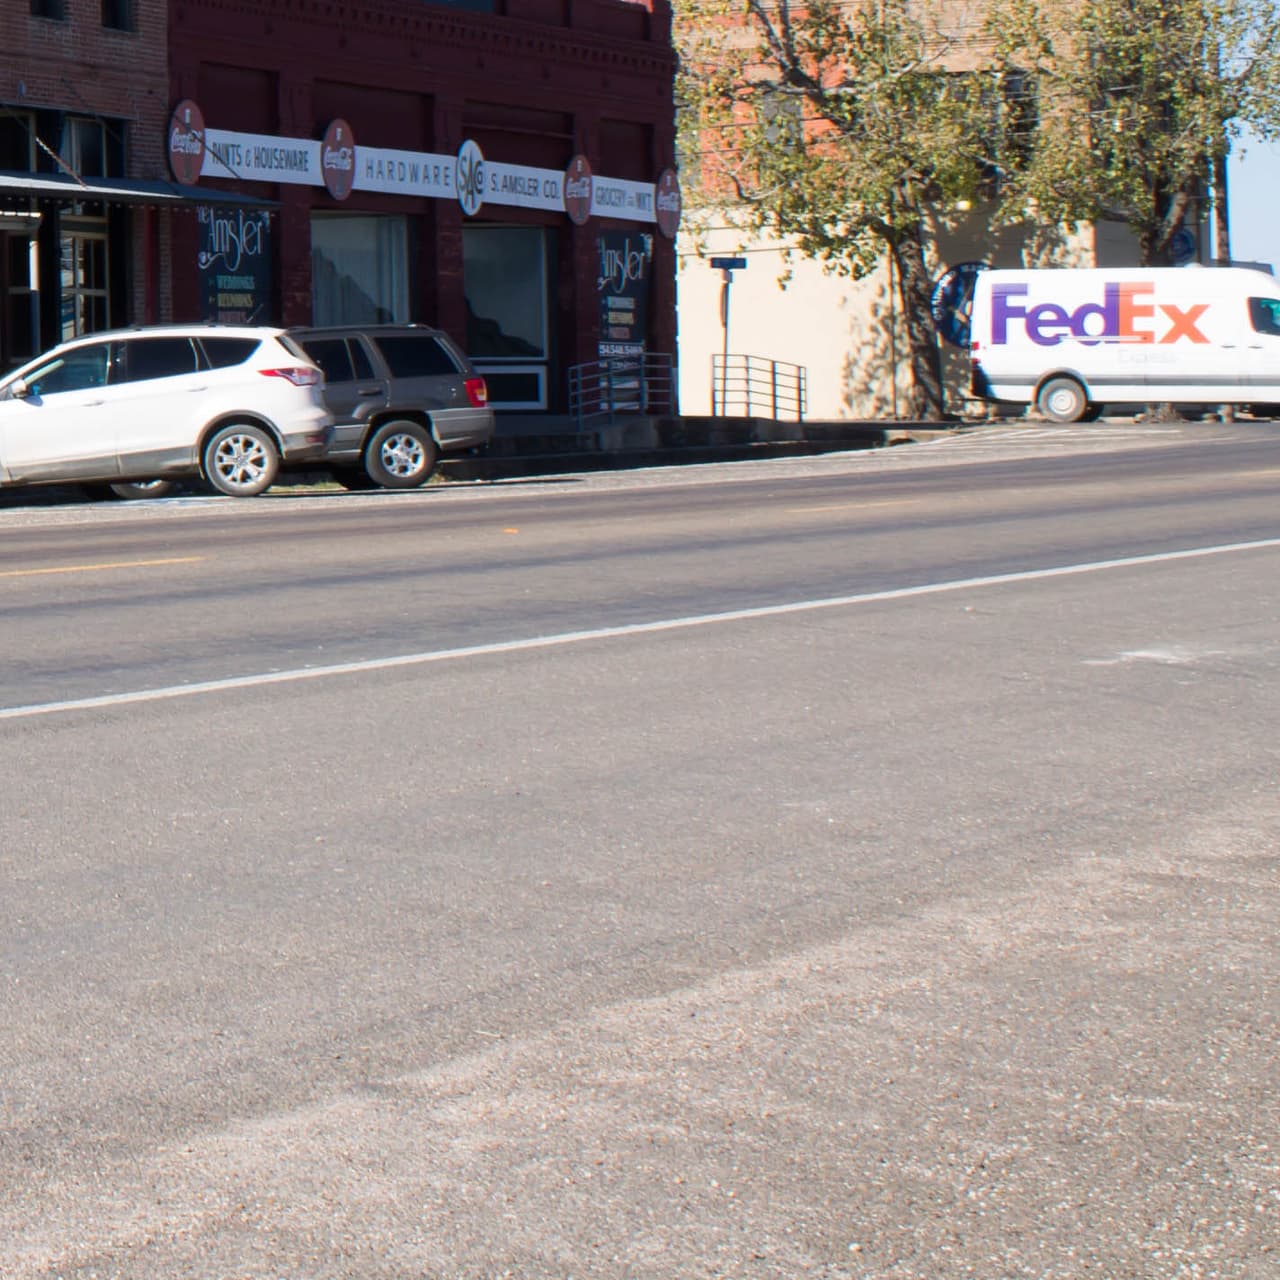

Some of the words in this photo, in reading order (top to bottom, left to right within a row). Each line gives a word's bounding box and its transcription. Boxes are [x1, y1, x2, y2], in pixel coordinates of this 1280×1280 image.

[253, 145, 310, 173] HOUSEWARE
[365, 158, 451, 187] HARDWARE
[501, 174, 539, 197] AMSLER
[207, 207, 262, 272] Amsler
[990, 281, 1212, 347] FedEx
